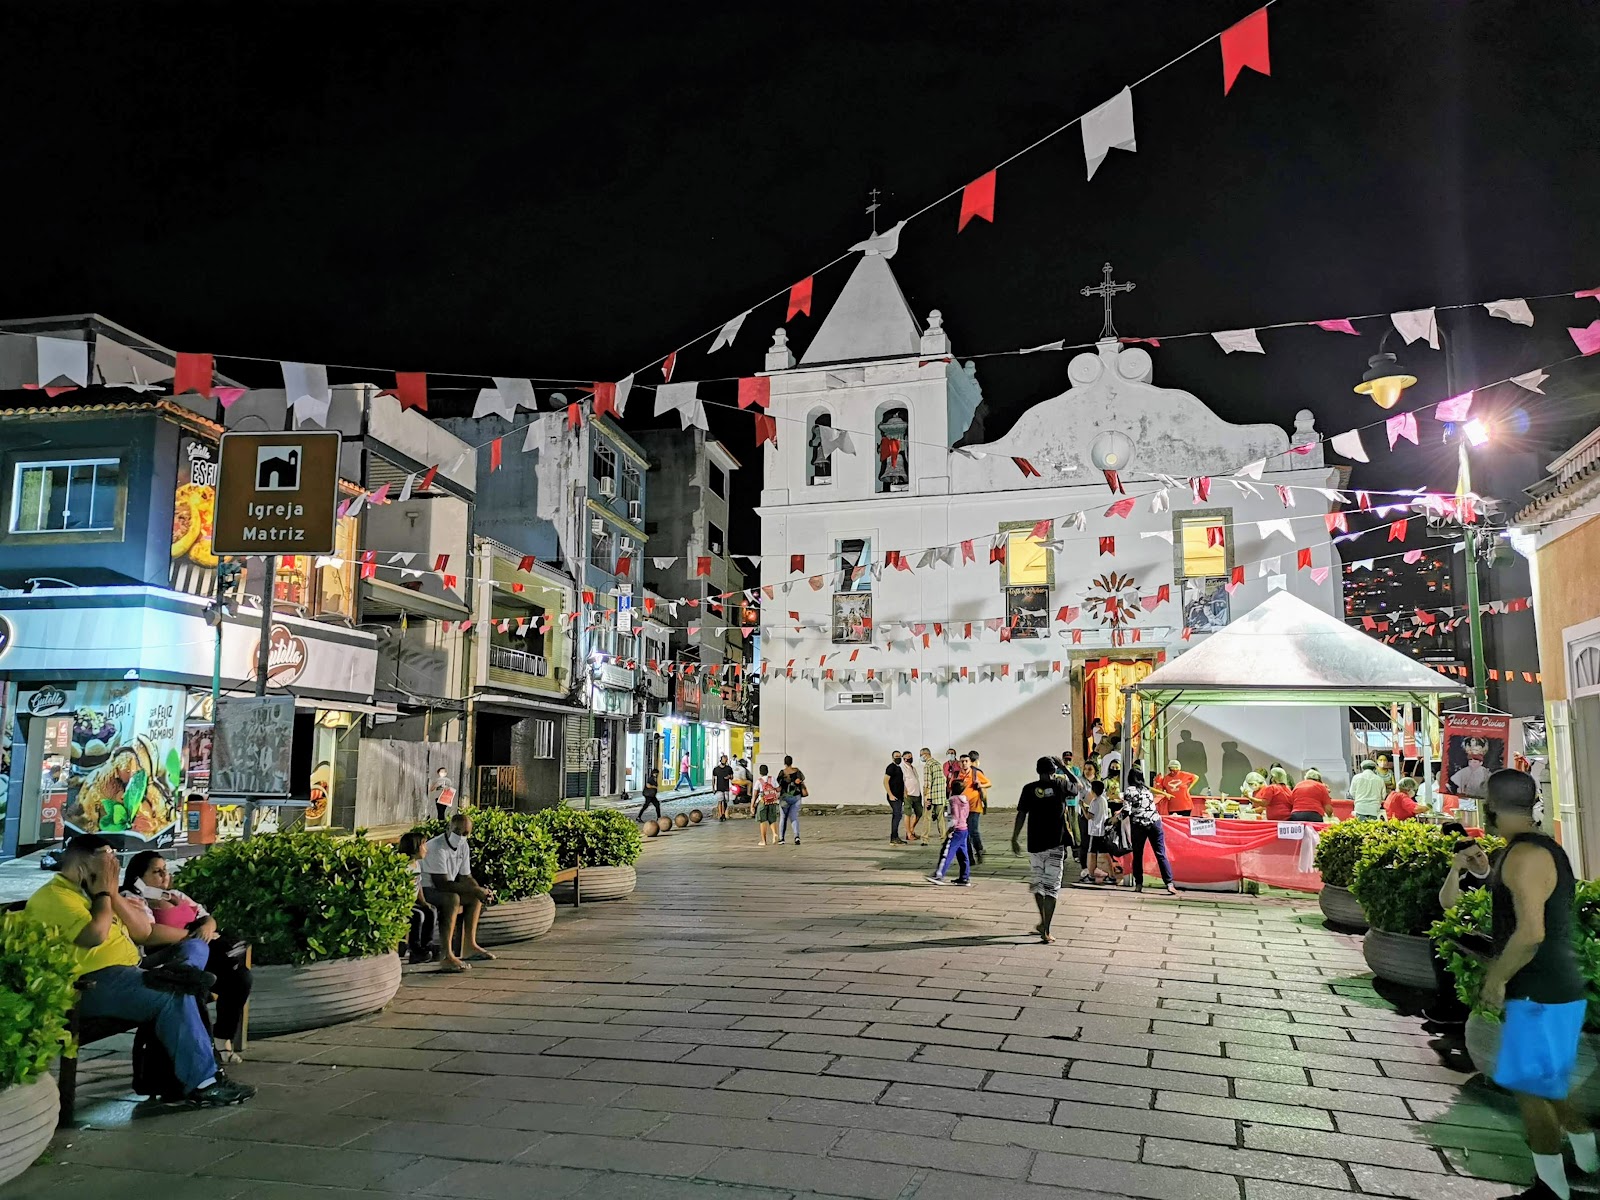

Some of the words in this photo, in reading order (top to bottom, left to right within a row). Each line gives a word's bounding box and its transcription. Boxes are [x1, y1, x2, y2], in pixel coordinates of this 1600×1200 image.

[191, 460, 218, 486] ESFI
[248, 502, 304, 520] Igreja
[243, 527, 305, 540] Matriz
[31, 692, 65, 713] Gutella
[1448, 714, 1468, 726] Festa
[1470, 717, 1479, 725] do
[1481, 716, 1506, 728] Divino
